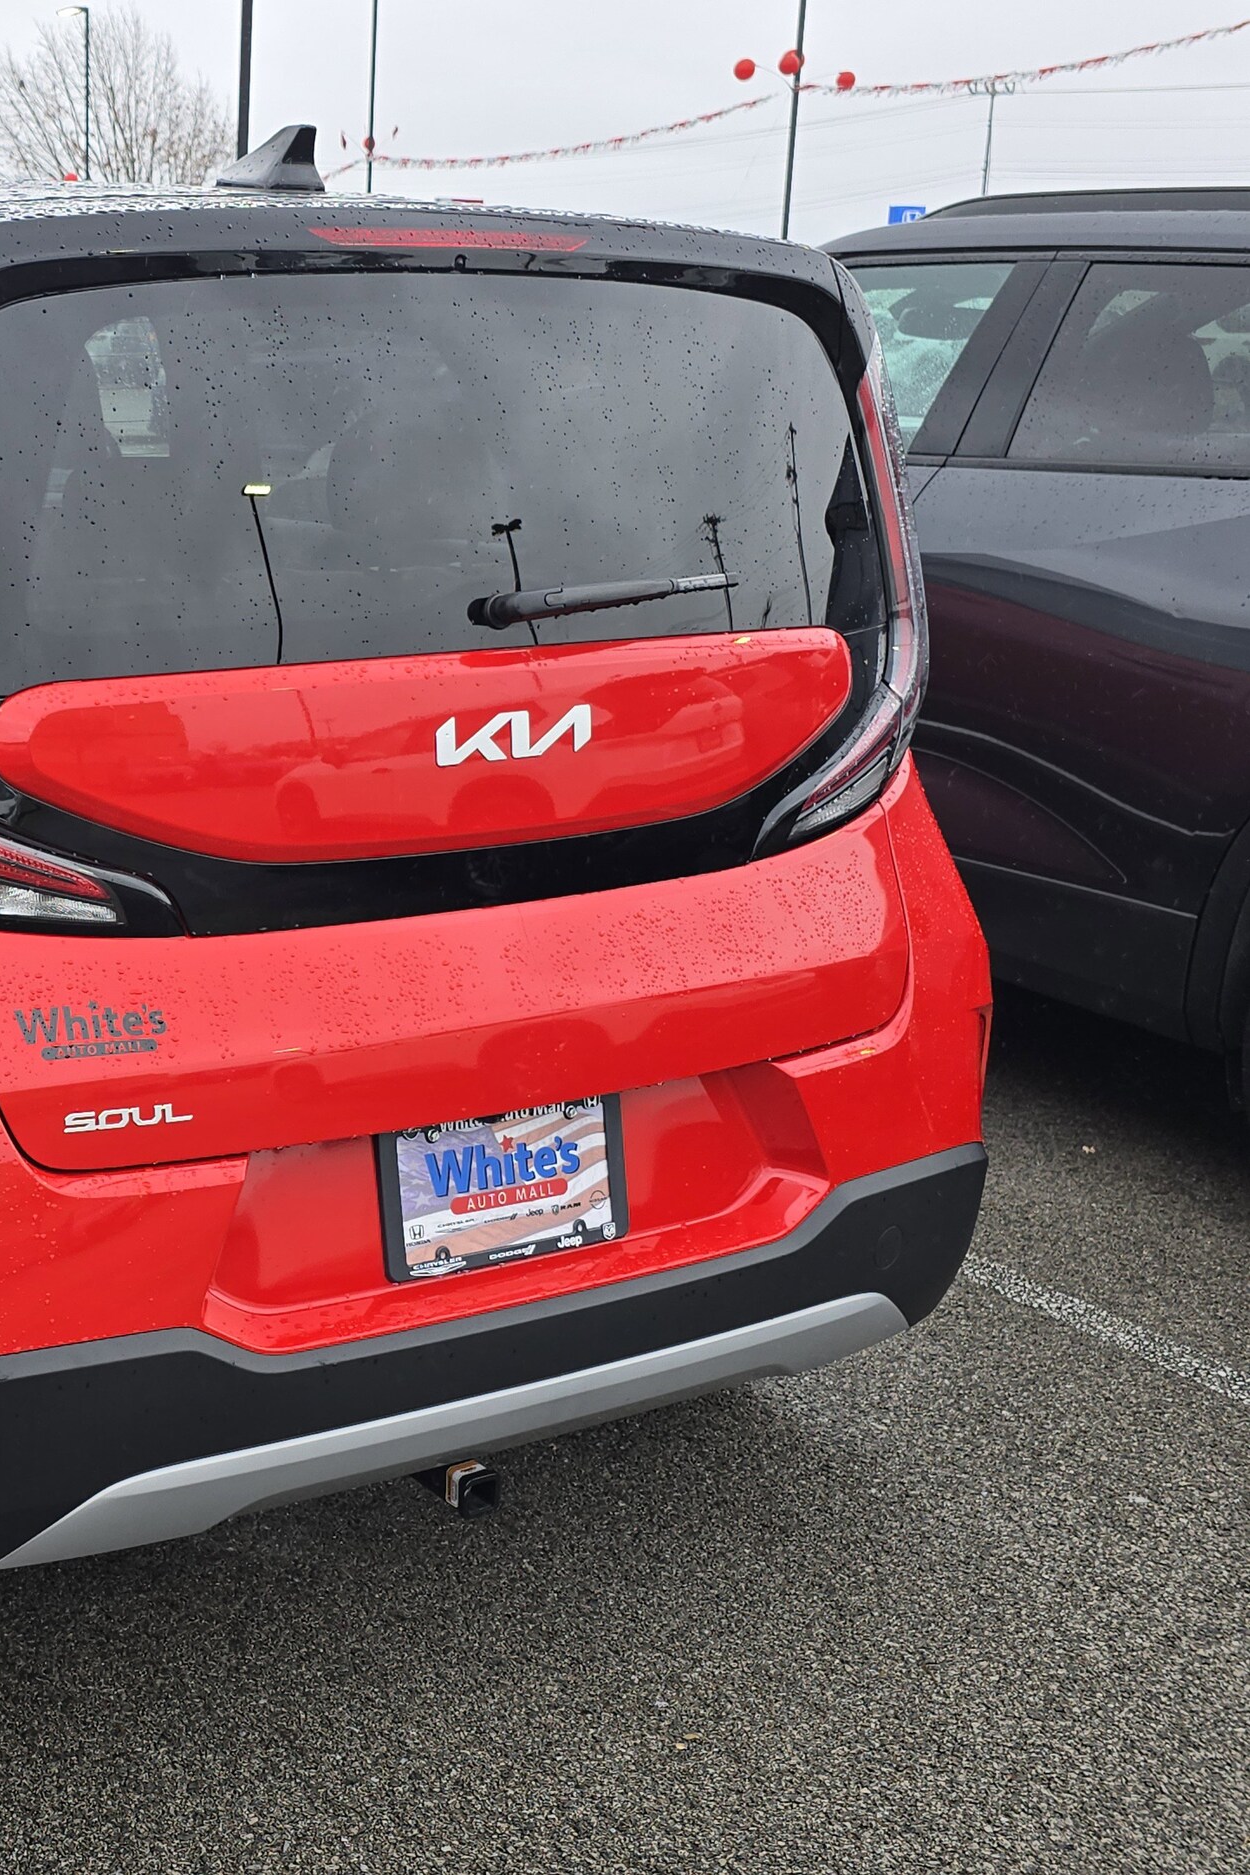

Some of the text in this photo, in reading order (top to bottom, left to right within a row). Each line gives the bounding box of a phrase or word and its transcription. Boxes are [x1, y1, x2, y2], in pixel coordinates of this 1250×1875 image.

[435, 704, 592, 767] KIA
[13, 1001, 168, 1045] White's
[55, 1040, 145, 1060] AUTO MALL
[63, 1103, 194, 1134] SOUL
[424, 1135, 580, 1198] White's
[466, 1183, 554, 1210] AUTO MALL
[560, 1201, 581, 1210] RAM
[525, 1208, 544, 1217] Jeep
[557, 1234, 583, 1248] Jeep
[413, 1257, 463, 1270] CHRYSLER
